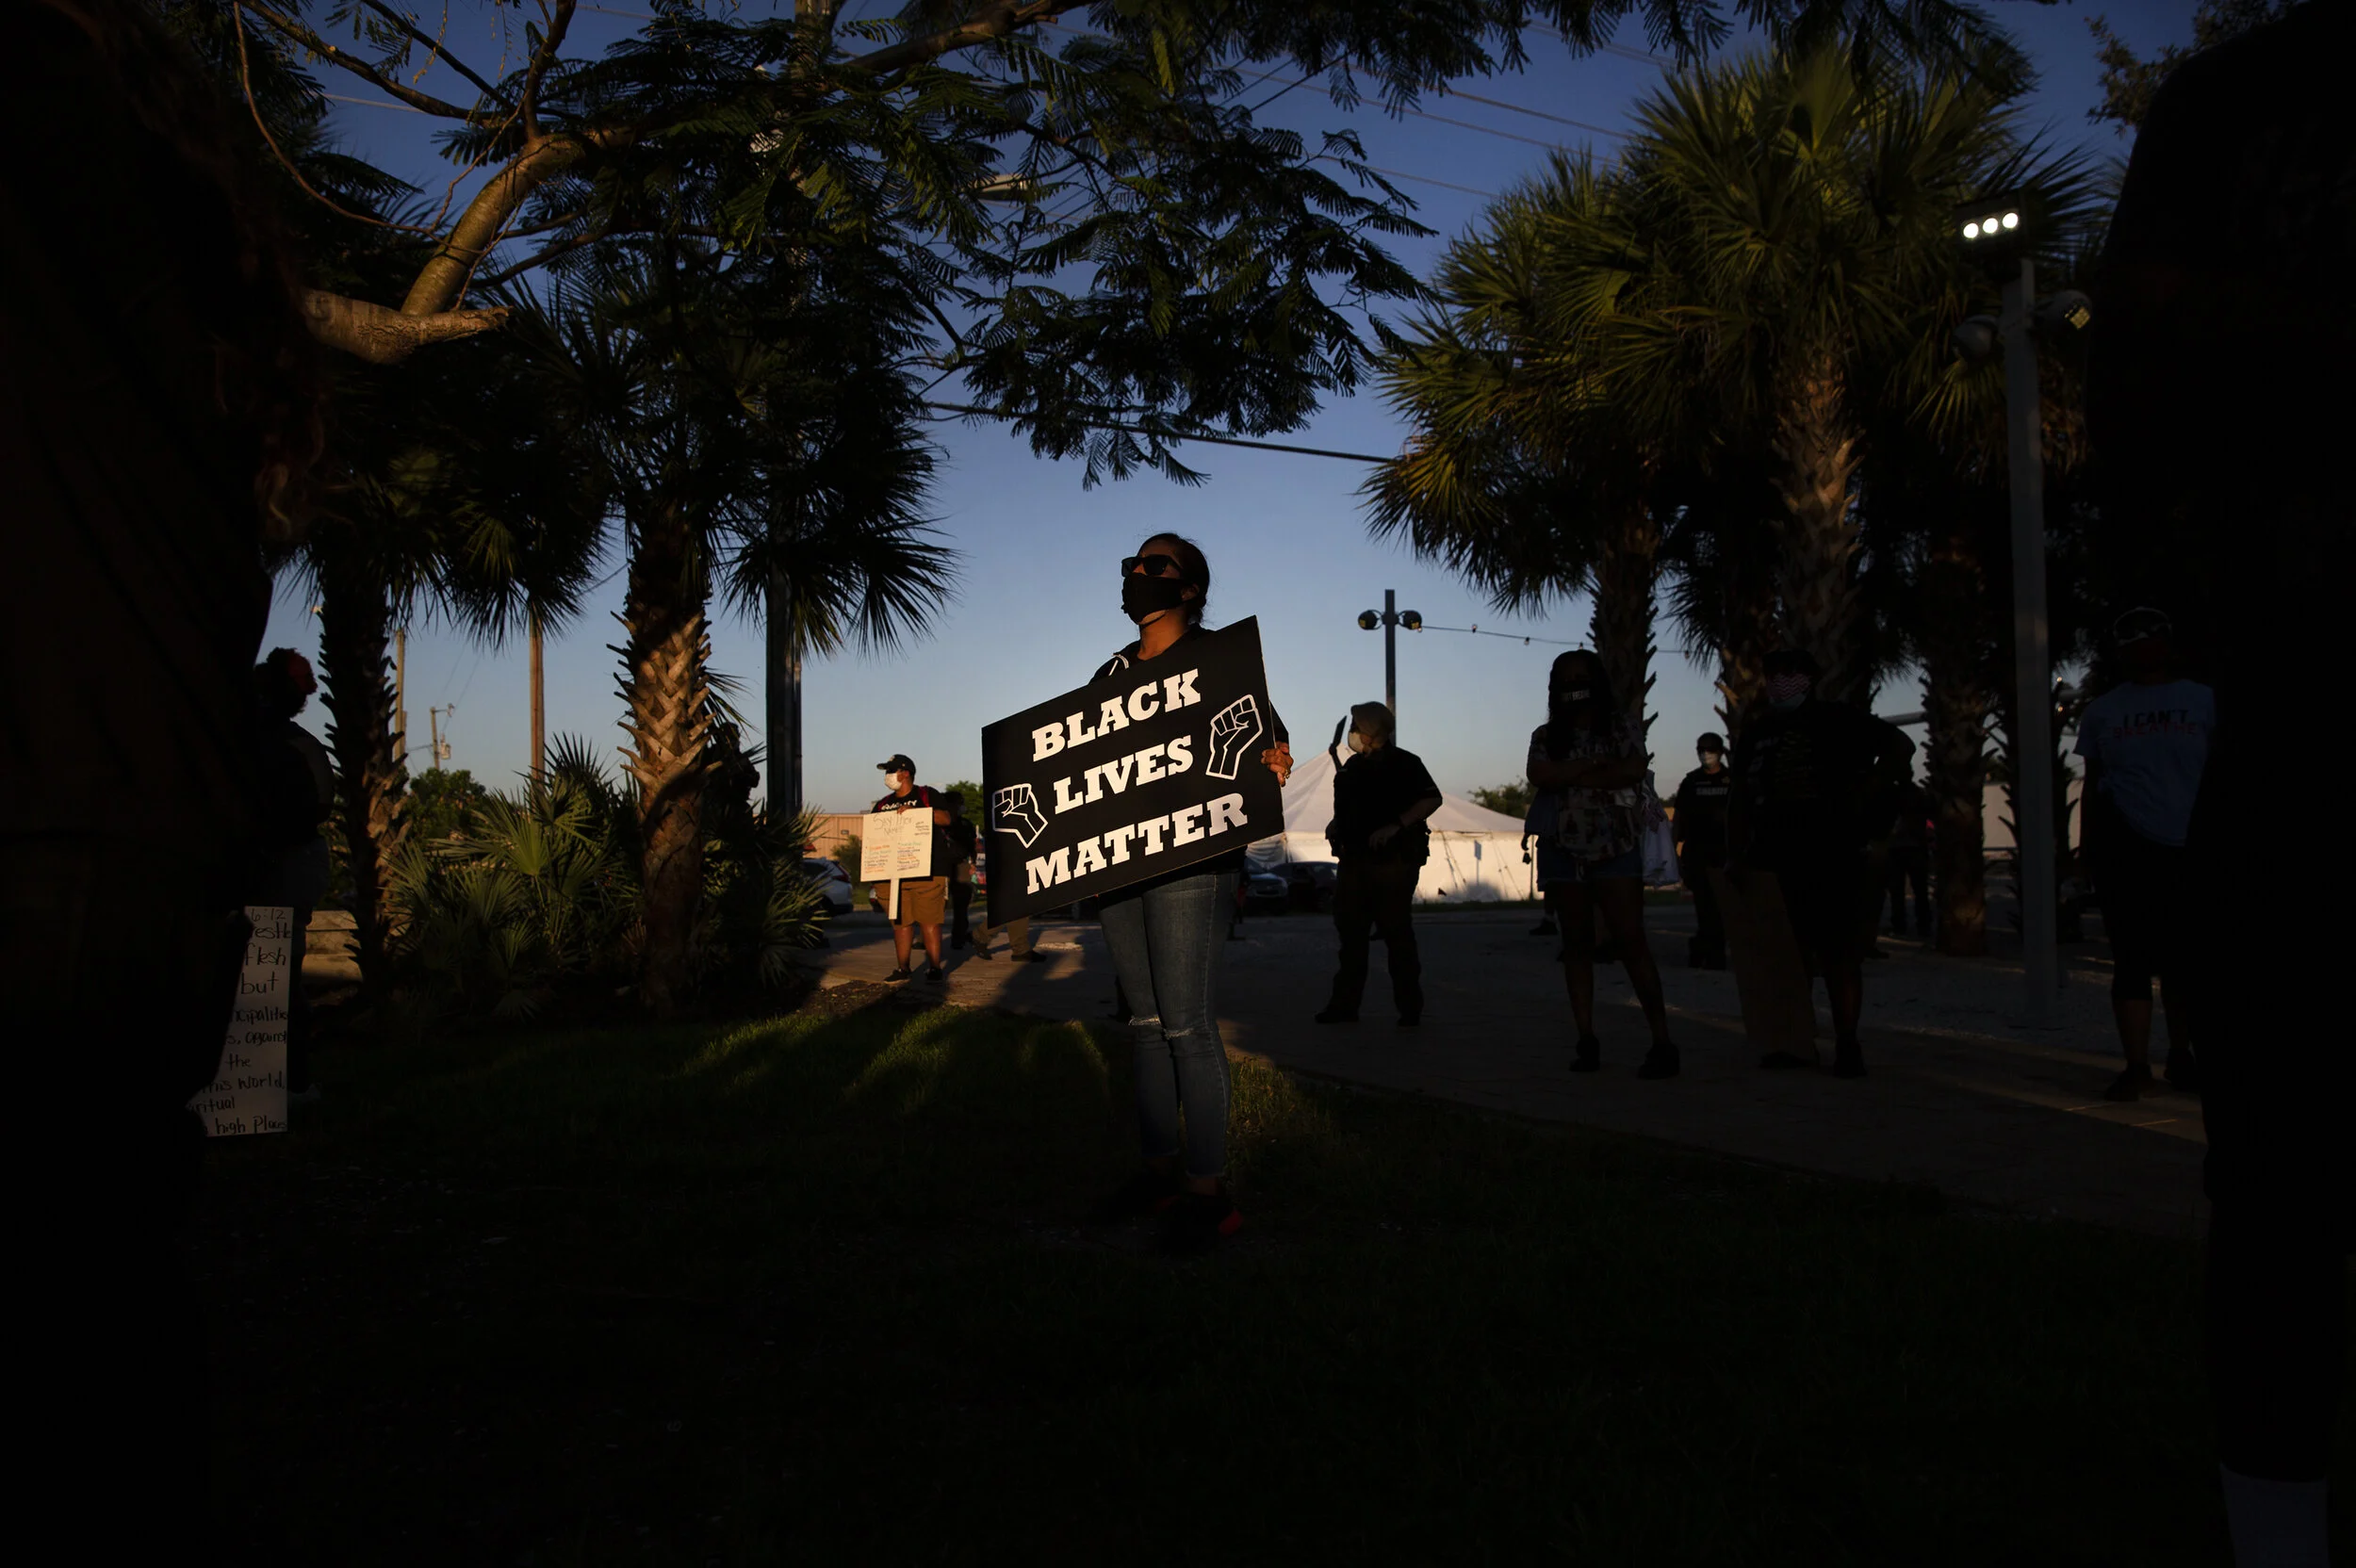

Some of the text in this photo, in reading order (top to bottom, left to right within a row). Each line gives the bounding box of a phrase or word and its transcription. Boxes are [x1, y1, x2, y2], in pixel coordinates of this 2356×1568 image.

[1032, 668, 1202, 762] BLACK
[2134, 709, 2189, 727] CAN'T
[1053, 734, 1194, 815] LIVES
[1025, 792, 1249, 895] MATTER
[252, 908, 286, 923] 6:12
[244, 942, 286, 966] flesh
[240, 972, 280, 995] but
[244, 1030, 286, 1046] against
[224, 1053, 253, 1071] the
[190, 1095, 236, 1113] ritual
[215, 1117, 246, 1135] high
